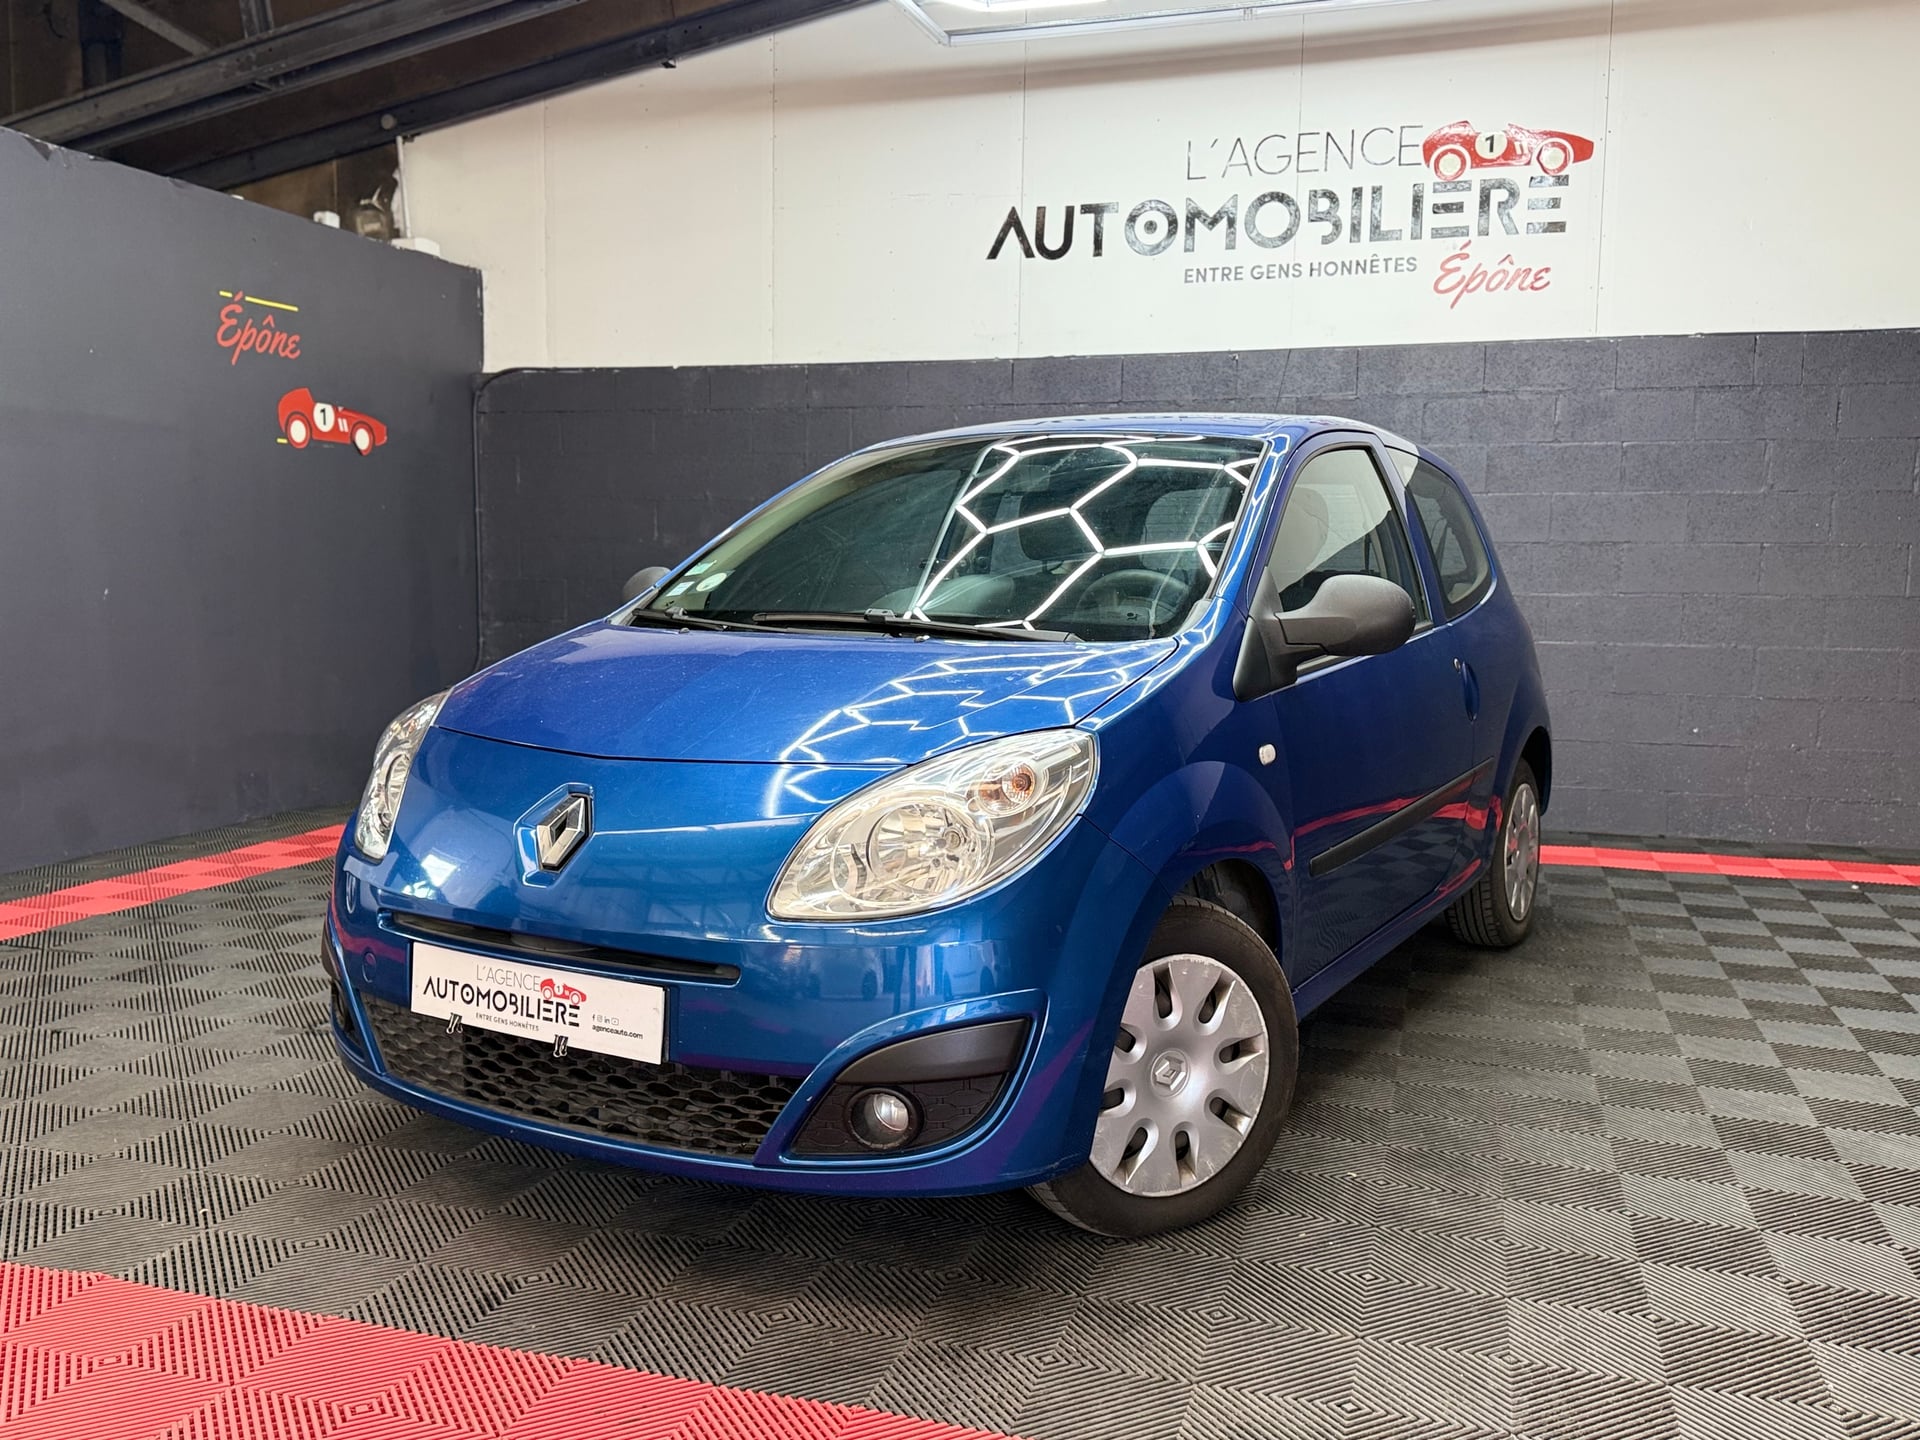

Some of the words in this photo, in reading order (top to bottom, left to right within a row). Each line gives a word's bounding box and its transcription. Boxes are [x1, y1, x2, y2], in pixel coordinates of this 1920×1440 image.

[1186, 124, 1424, 181] L'AGENCE
[1485, 134, 1495, 153] 1
[1184, 265, 1244, 284] ENTRE
[1250, 262, 1303, 281] GENS
[1309, 253, 1418, 278] HONNÊTES
[1432, 239, 1552, 310] Épône
[216, 290, 301, 366] Épône
[319, 407, 328, 426] 1
[476, 964, 541, 993] L'AGENCE
[475, 1012, 493, 1022] ENTRE
[493, 1016, 509, 1026] GENS
[592, 1024, 644, 1040] agenceauto.com
